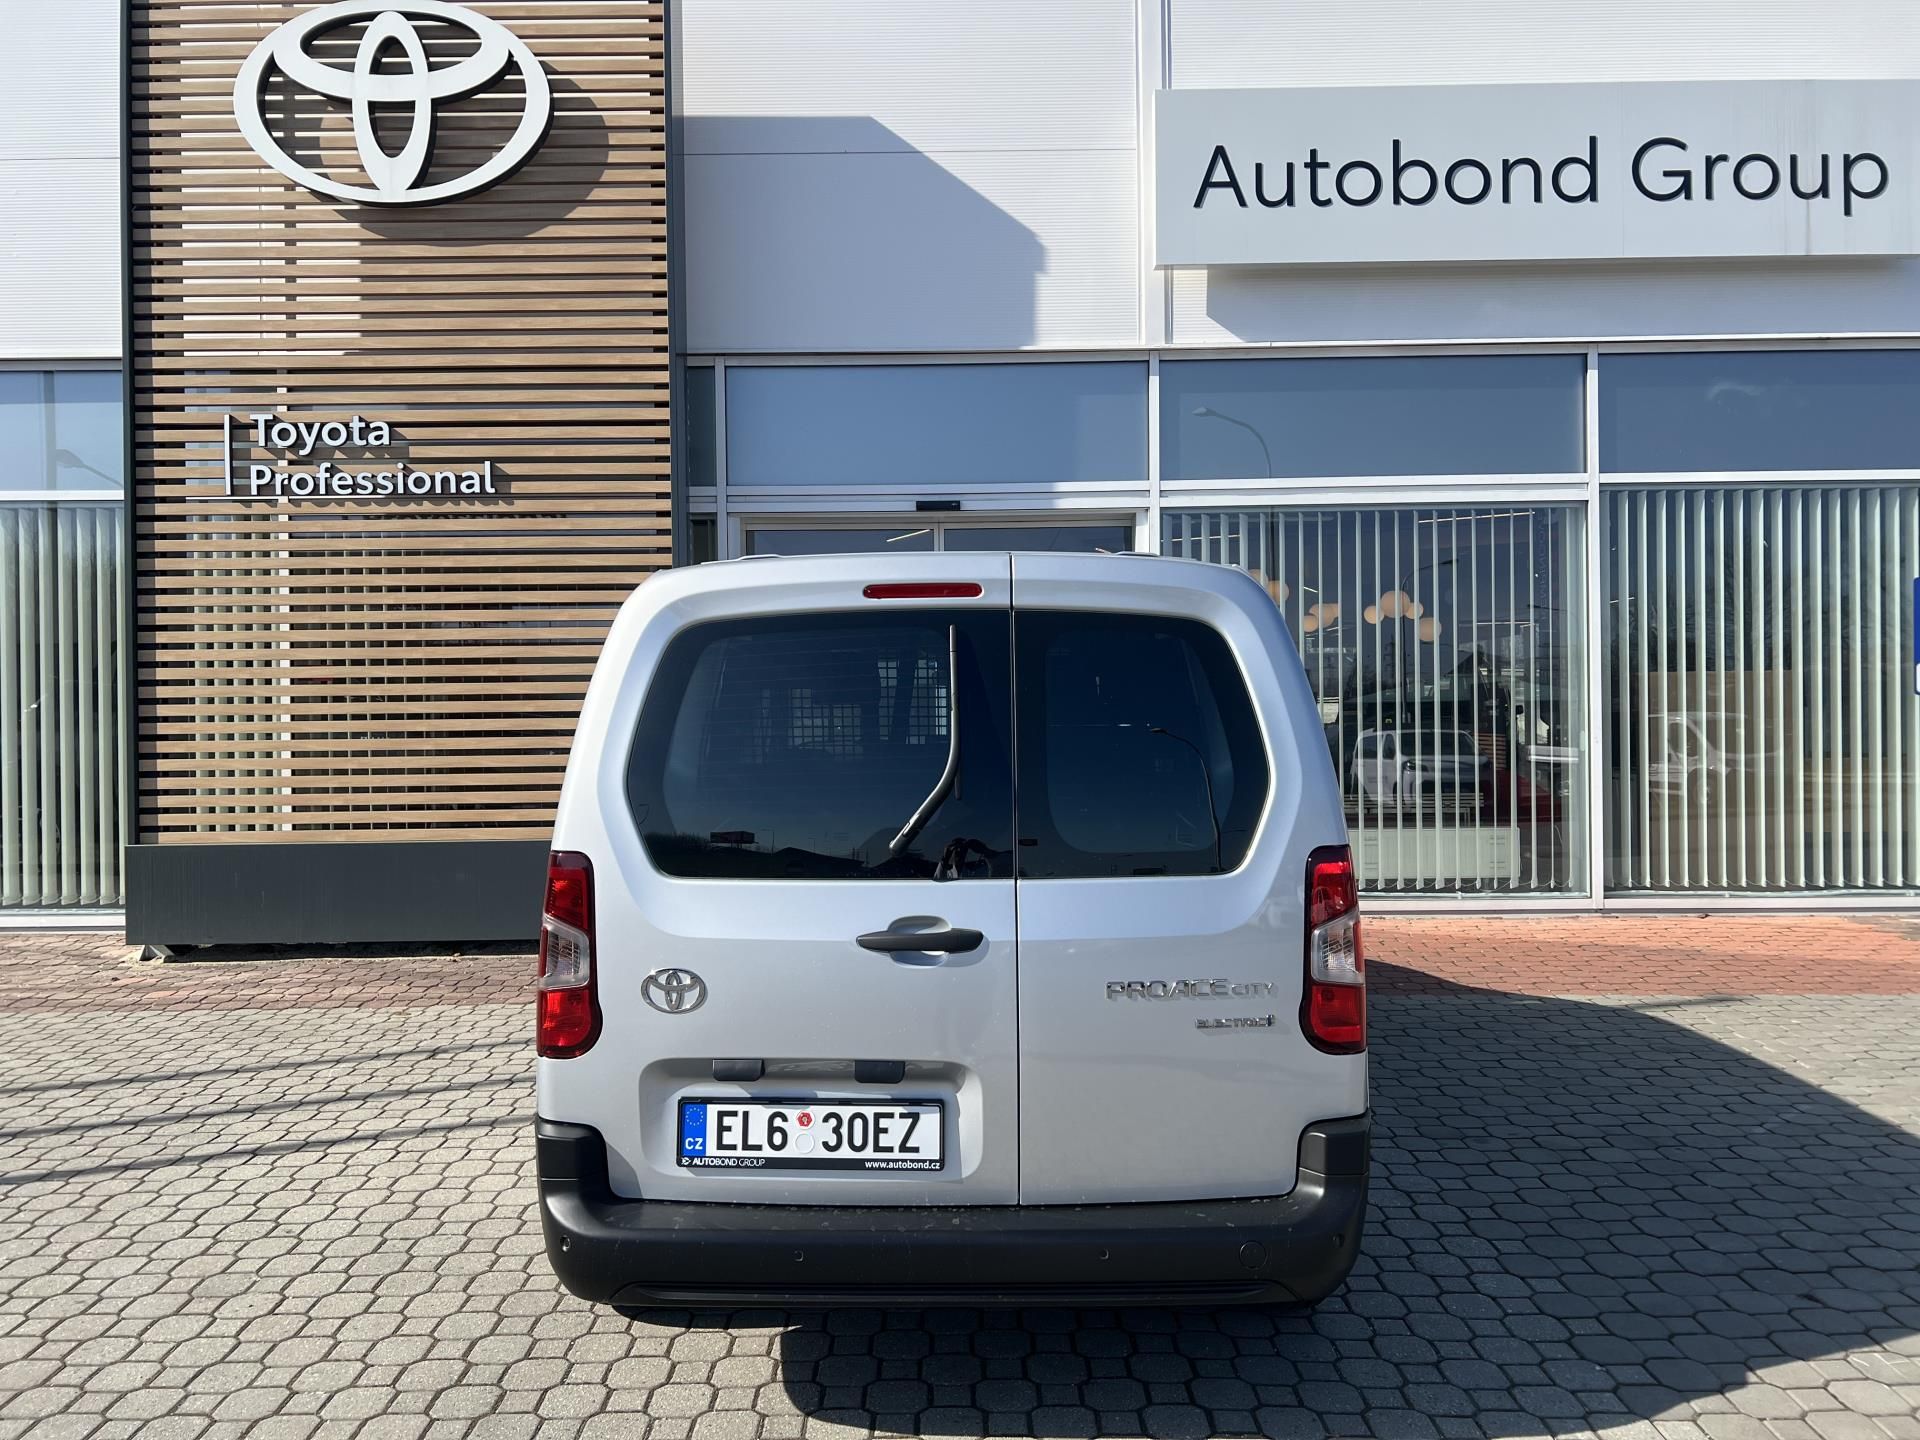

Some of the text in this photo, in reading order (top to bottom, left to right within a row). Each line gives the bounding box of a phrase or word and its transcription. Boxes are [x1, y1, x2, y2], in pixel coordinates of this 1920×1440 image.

[1193, 135, 1889, 217] Autobond Group
[250, 413, 391, 456] Toyota
[250, 460, 496, 496] Professional
[1106, 978, 1275, 1001] PROACE CITY
[685, 1138, 704, 1151] CZ
[716, 1110, 921, 1154] EL6 30EZ
[692, 1157, 765, 1167] AUTOBOND GROUP
[864, 1159, 940, 1169] www.autobond.cz
